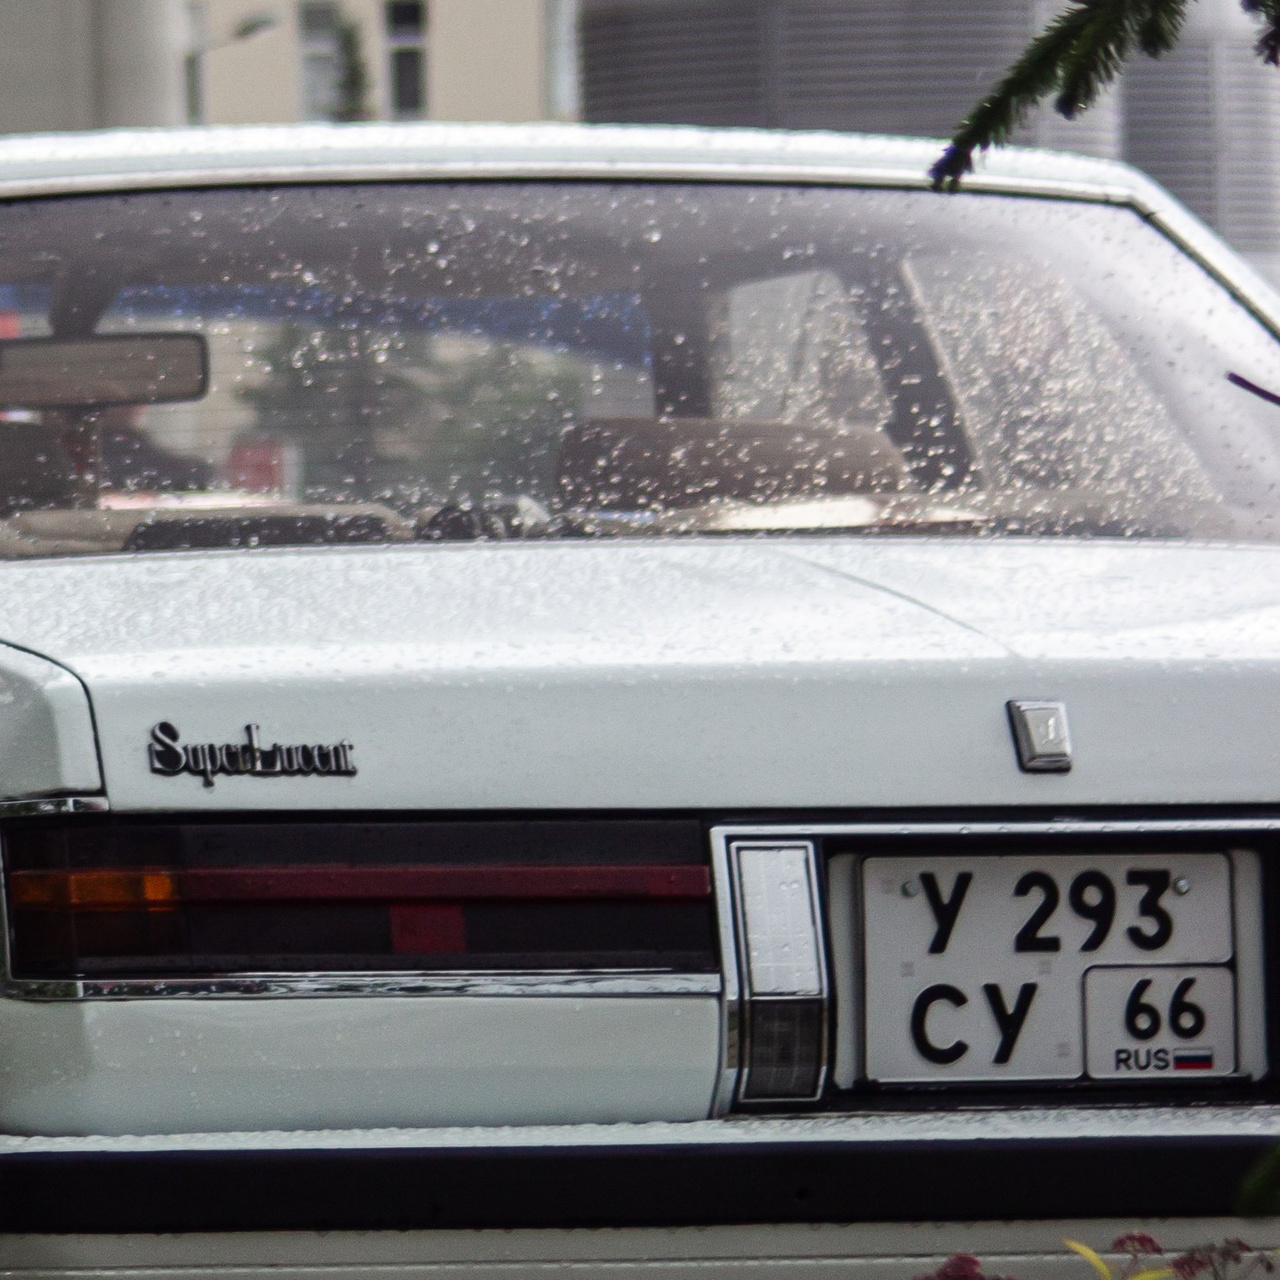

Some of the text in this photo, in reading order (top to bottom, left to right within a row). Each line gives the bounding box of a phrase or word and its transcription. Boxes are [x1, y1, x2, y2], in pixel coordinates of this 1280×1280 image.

[1013, 870, 1173, 952] 293
[1125, 977, 1206, 1039] 66
[1114, 1048, 1170, 1071] RUS
